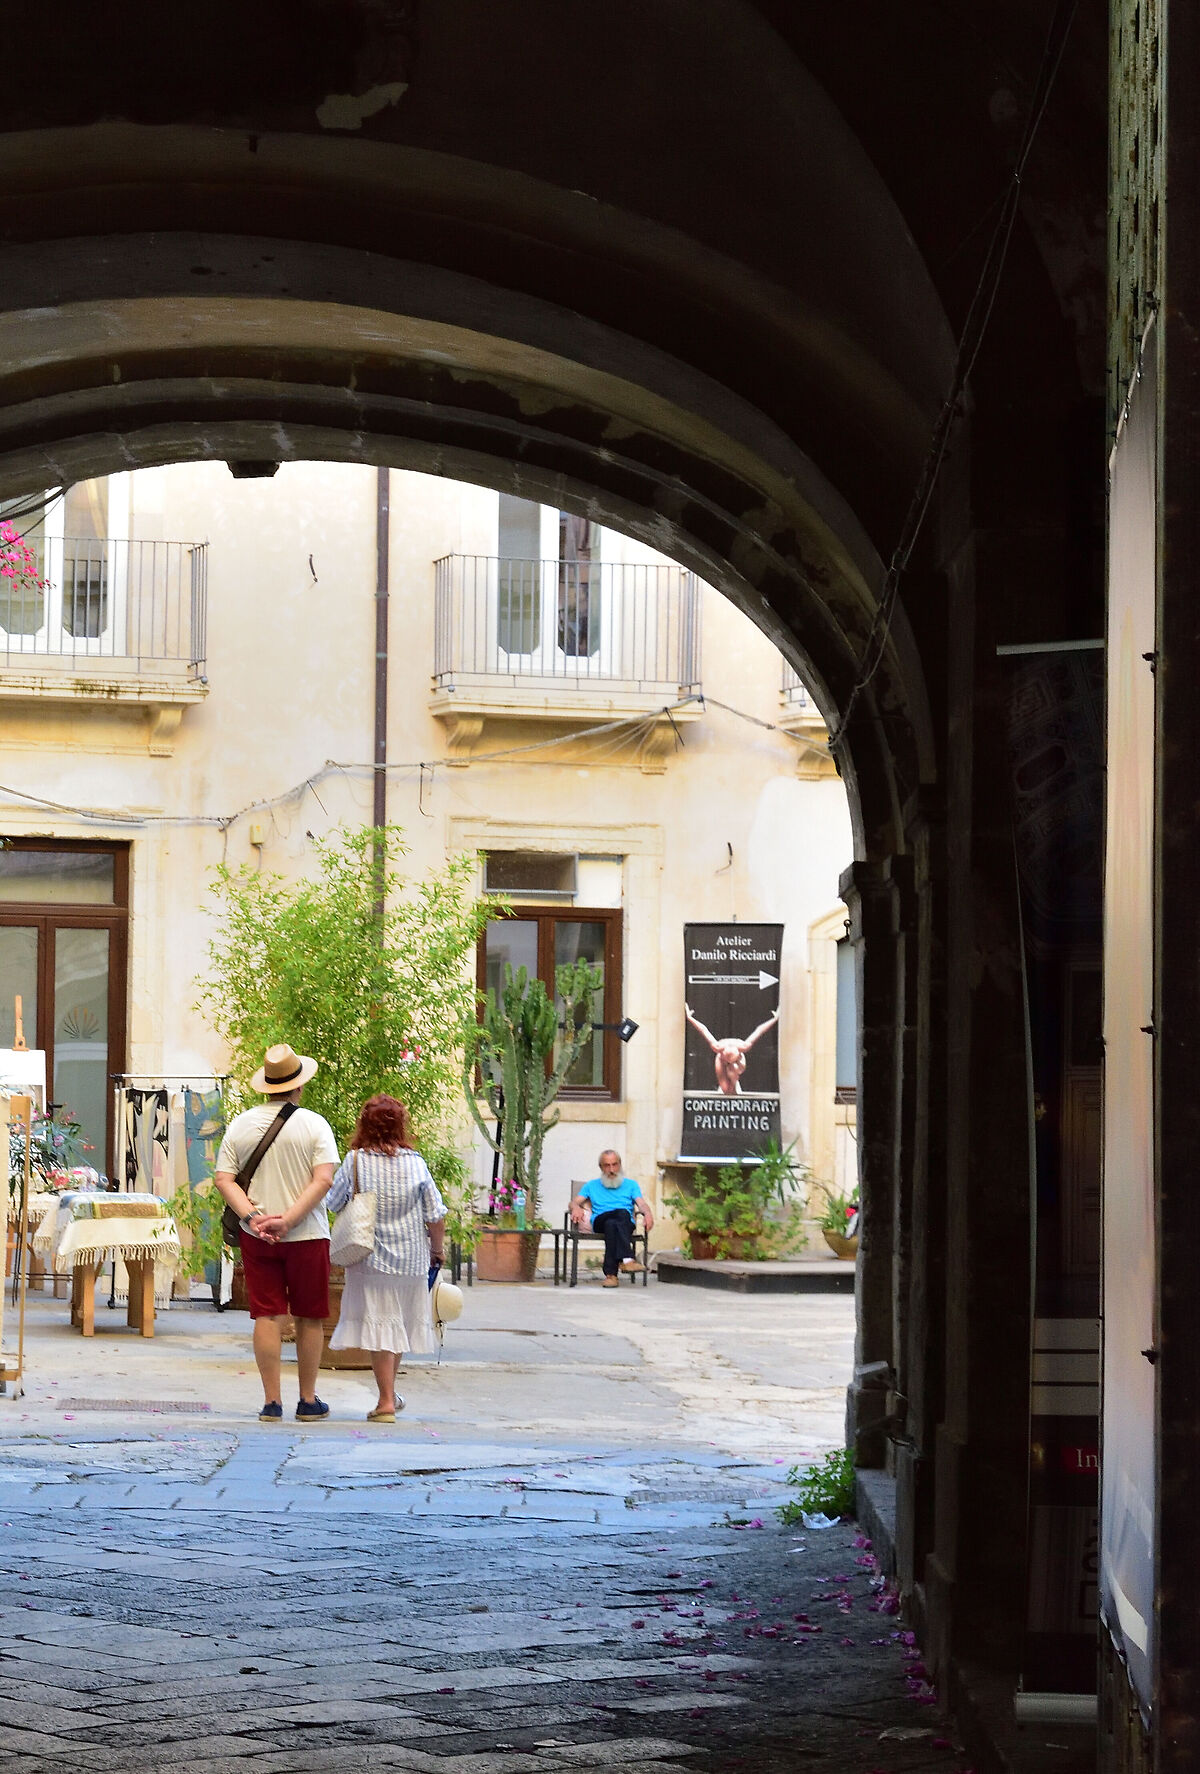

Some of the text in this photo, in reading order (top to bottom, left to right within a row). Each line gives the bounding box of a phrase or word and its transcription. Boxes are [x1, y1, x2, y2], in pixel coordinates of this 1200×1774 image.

[716, 935, 753, 946] Atelier
[692, 949, 776, 961] Danilo Ricciardi
[685, 1099, 778, 1113] CONTEMPORARY
[693, 1115, 770, 1131] PAINTING
